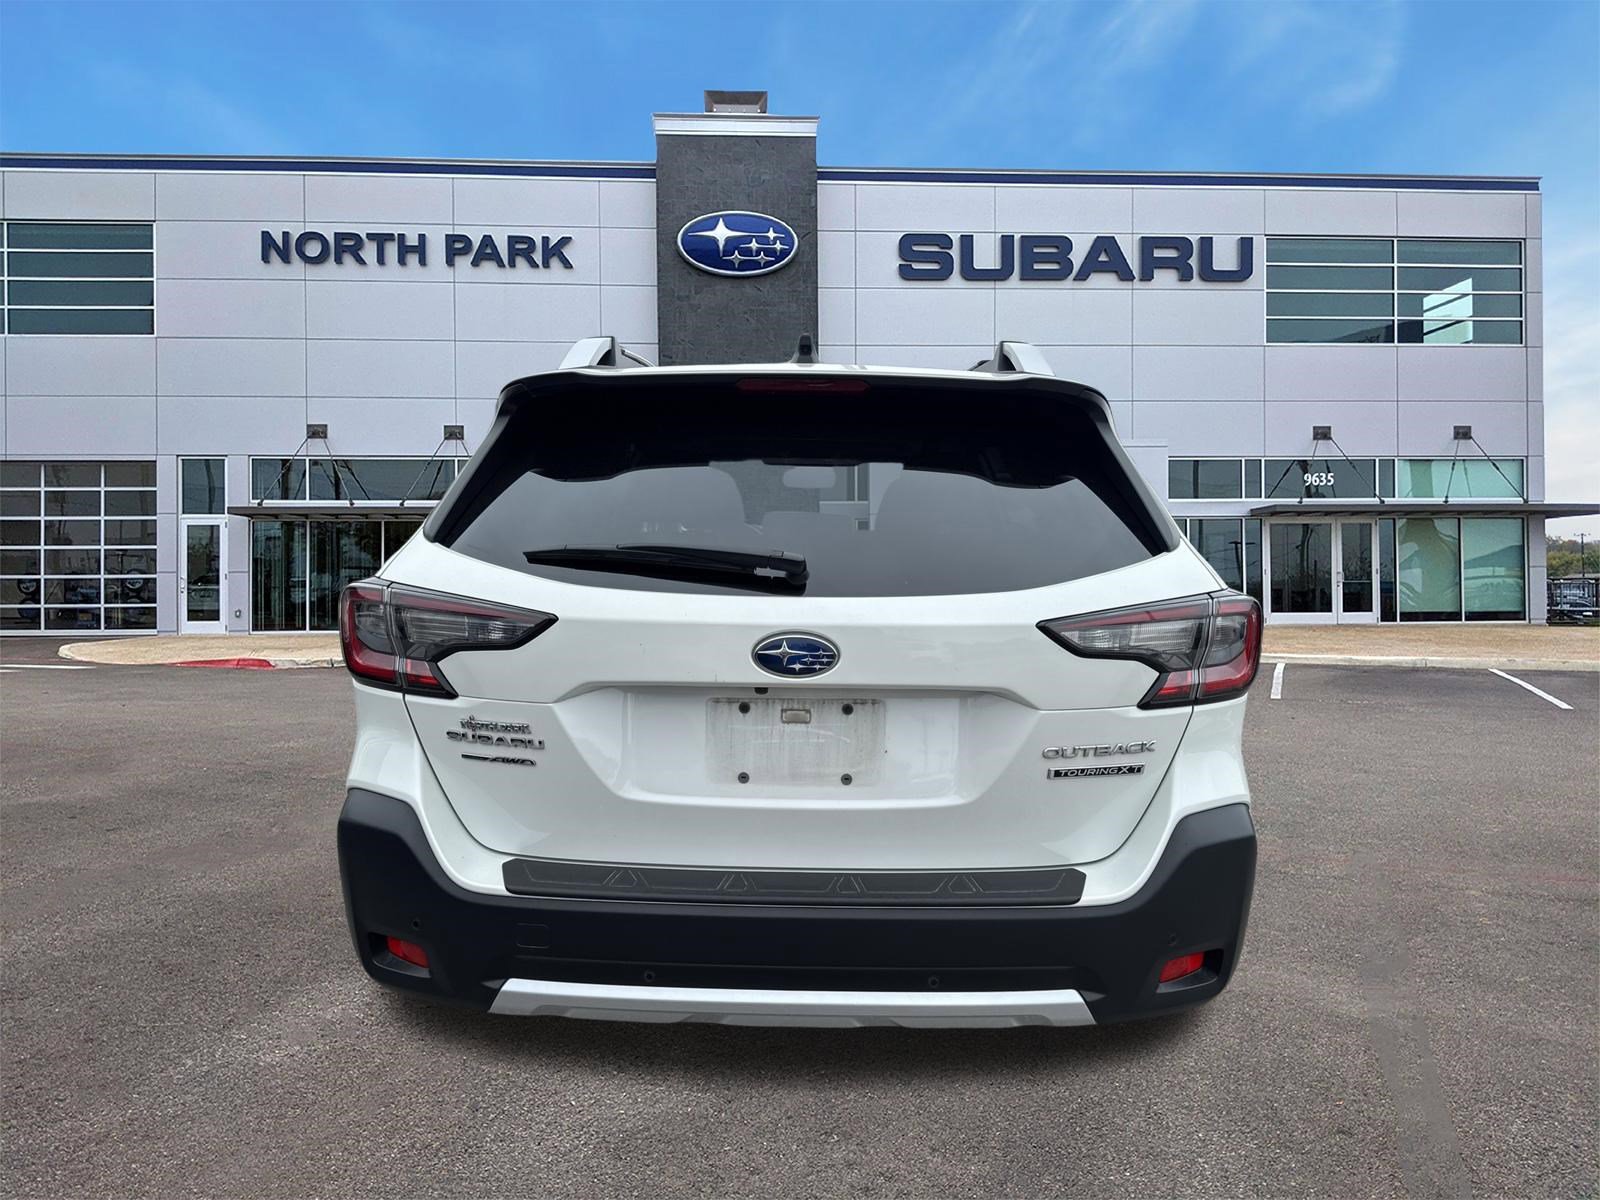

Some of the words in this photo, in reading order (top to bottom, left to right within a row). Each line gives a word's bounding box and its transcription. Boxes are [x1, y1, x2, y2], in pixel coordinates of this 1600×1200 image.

[260, 230, 427, 267] NORTH
[444, 233, 574, 269] PARK
[898, 232, 1254, 282] SUBARU
[1303, 472, 1335, 486] 9635
[446, 731, 545, 750] SUBARU
[1042, 740, 1156, 759] OUTBACK
